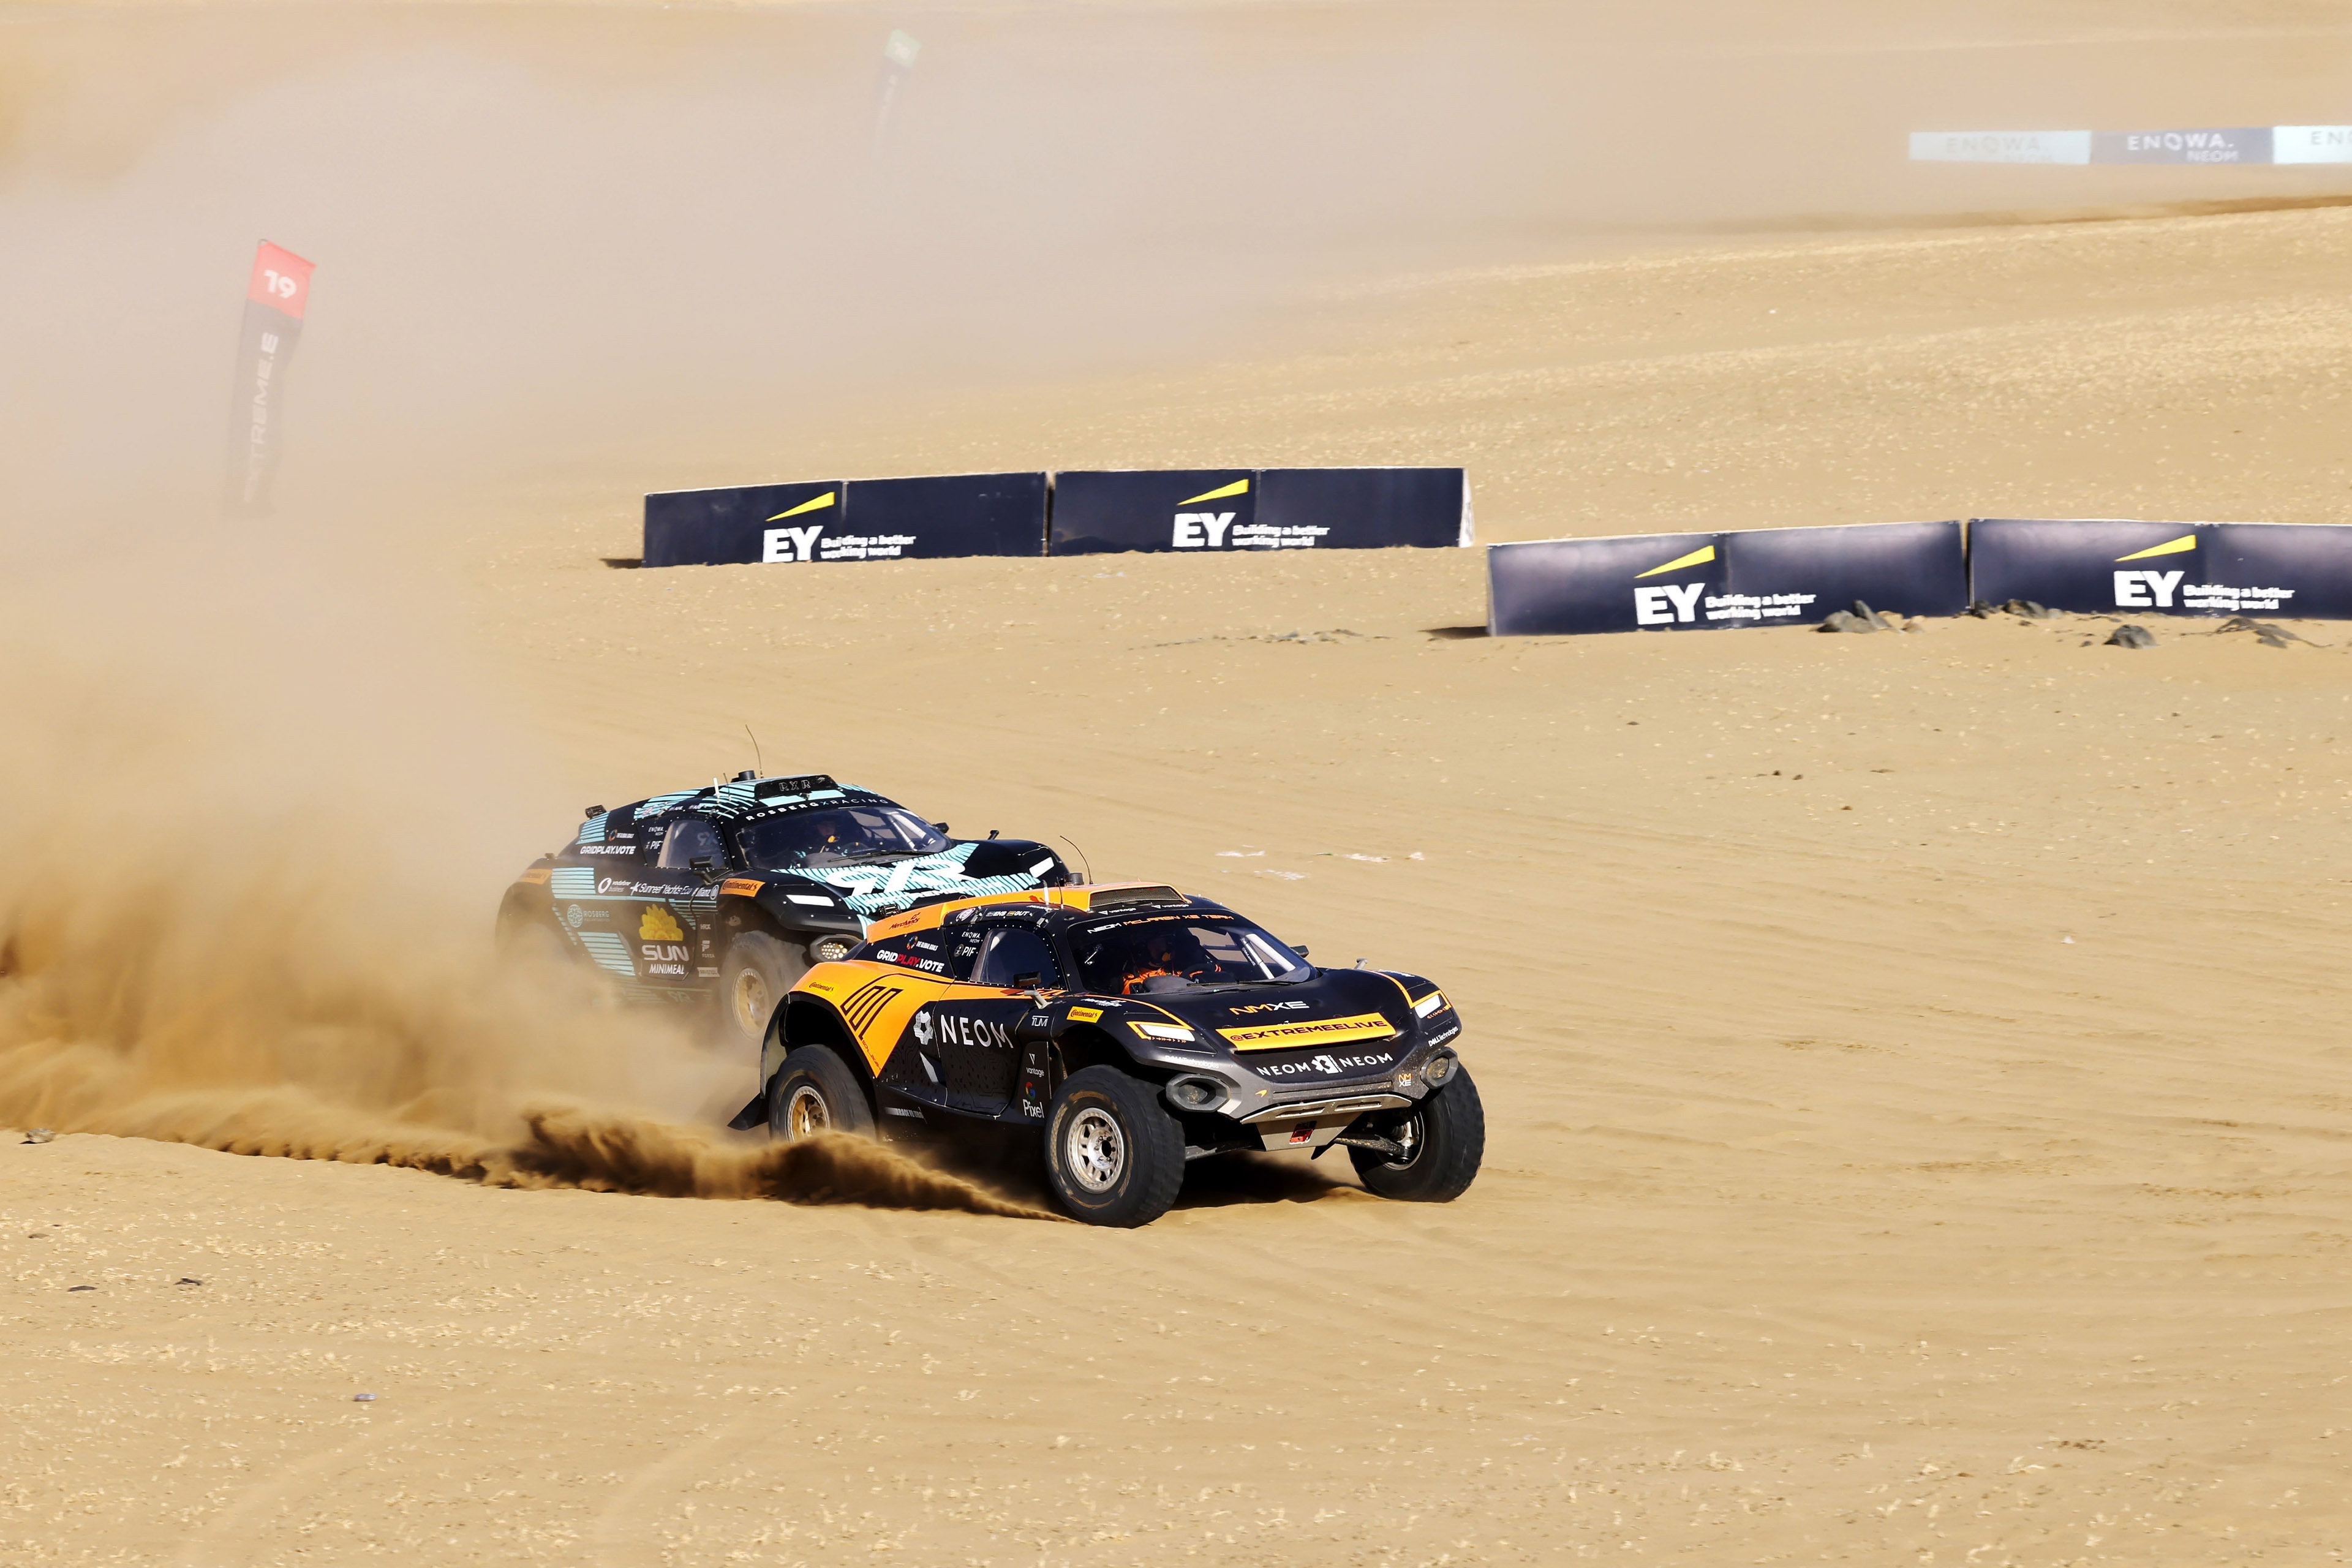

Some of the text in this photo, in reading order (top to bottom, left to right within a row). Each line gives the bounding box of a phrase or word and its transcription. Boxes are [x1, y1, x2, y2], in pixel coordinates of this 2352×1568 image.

[2187, 150, 2239, 162] NEOM
[264, 270, 298, 299] 19
[1172, 512, 1237, 547] EY
[763, 526, 824, 563] EY
[2114, 570, 2185, 607] EY
[1634, 582, 1706, 625] EY
[778, 780, 812, 792] RXR
[579, 845, 636, 855] GRIDPLAY.VOTE
[649, 840, 663, 850] PIF
[638, 883, 666, 894] Sunreef
[662, 884, 682, 894] Yachts
[723, 881, 755, 891] Continental
[1087, 922, 1122, 934] NEOM
[641, 944, 690, 962] SUN
[961, 946, 977, 957] PIF
[649, 963, 685, 974] MINIMEAL
[876, 949, 945, 973] GRIDPLAY.VOTE
[809, 981, 832, 992] Continental
[1070, 1009, 1095, 1018] Continental
[1229, 1000, 1310, 1015] NMXE
[940, 1014, 1014, 1049] NEOM
[1229, 1020, 1388, 1042] @EXTREMEELIVE
[1338, 1052, 1394, 1068] NEOM
[1025, 1066, 1045, 1078] vantage
[1256, 1061, 1311, 1077] NEOM
[1022, 1098, 1045, 1119] Pixel
